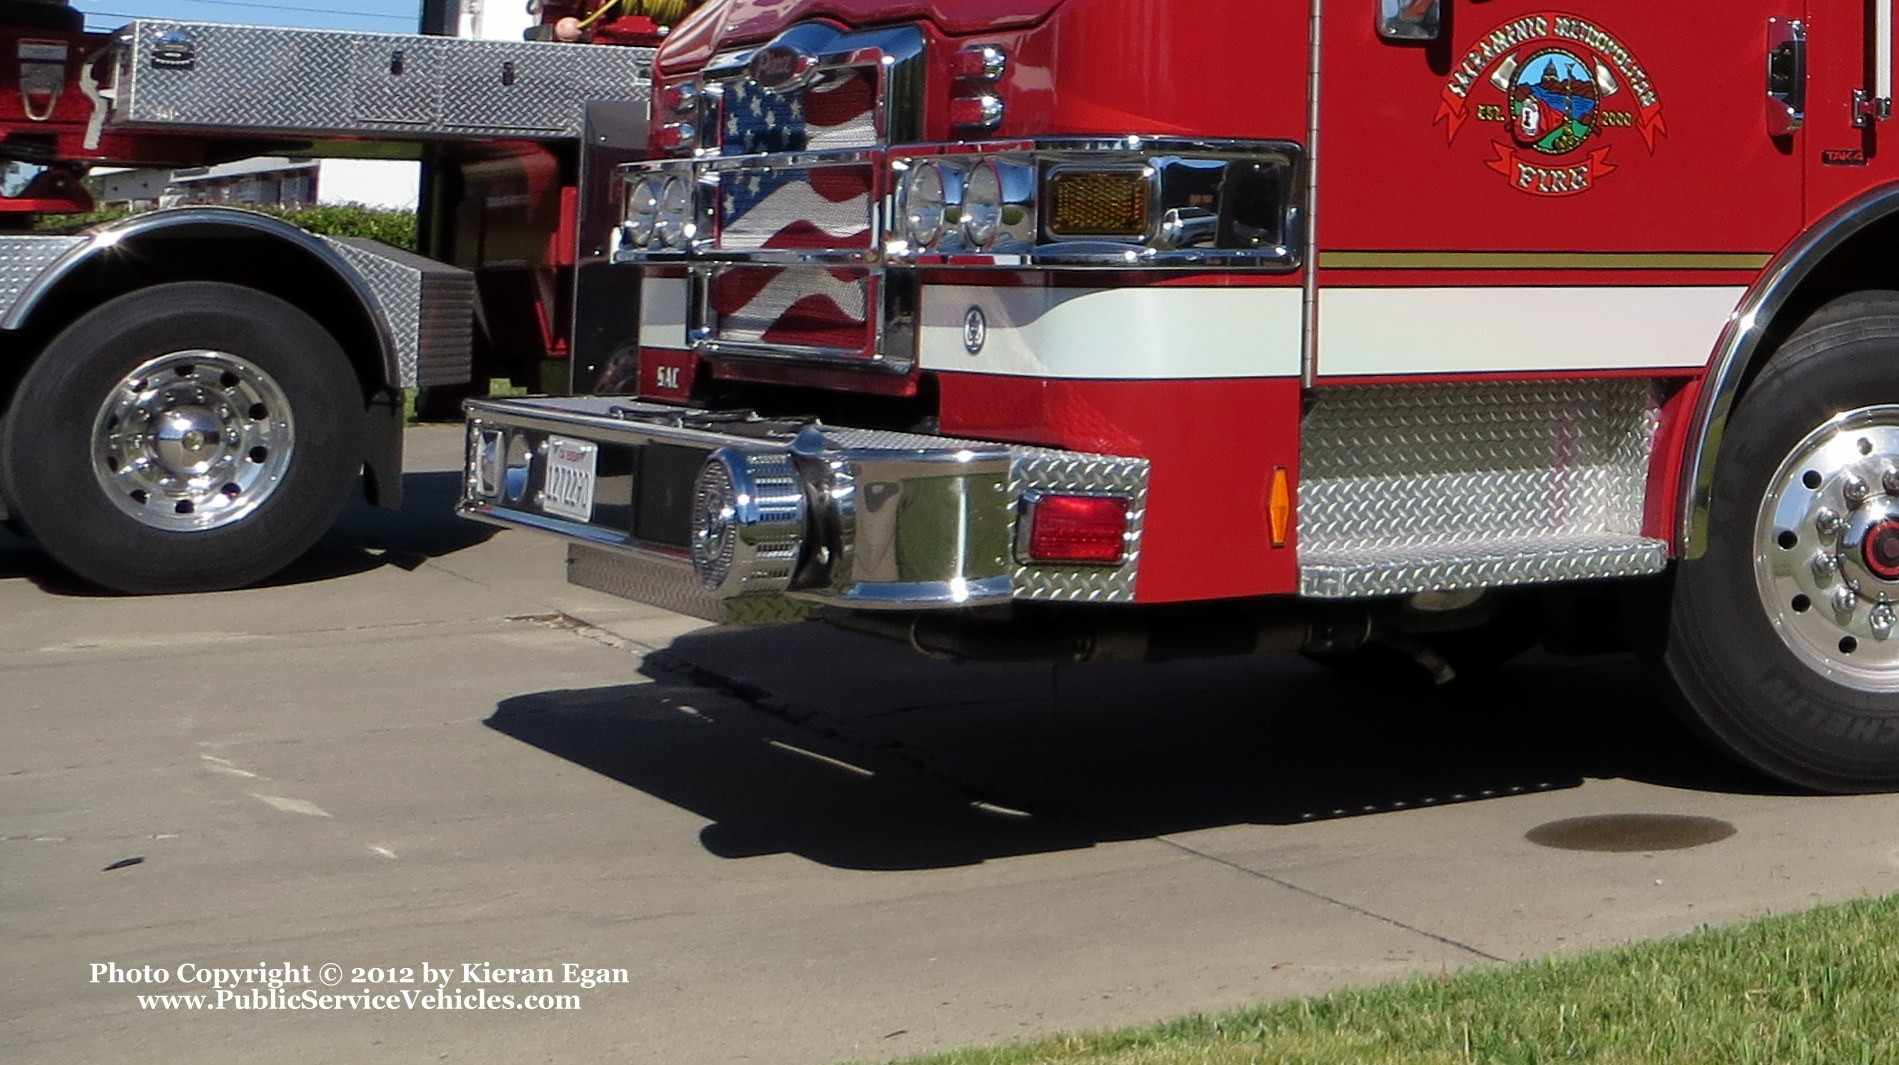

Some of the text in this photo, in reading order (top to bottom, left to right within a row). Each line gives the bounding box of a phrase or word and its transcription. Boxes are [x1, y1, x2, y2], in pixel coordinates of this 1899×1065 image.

[1448, 16, 1657, 107] SACRAMENTO METROPOLITAN
[1602, 112, 1633, 127] 2000
[1517, 163, 1589, 193] FIRE
[657, 366, 680, 389] SAC
